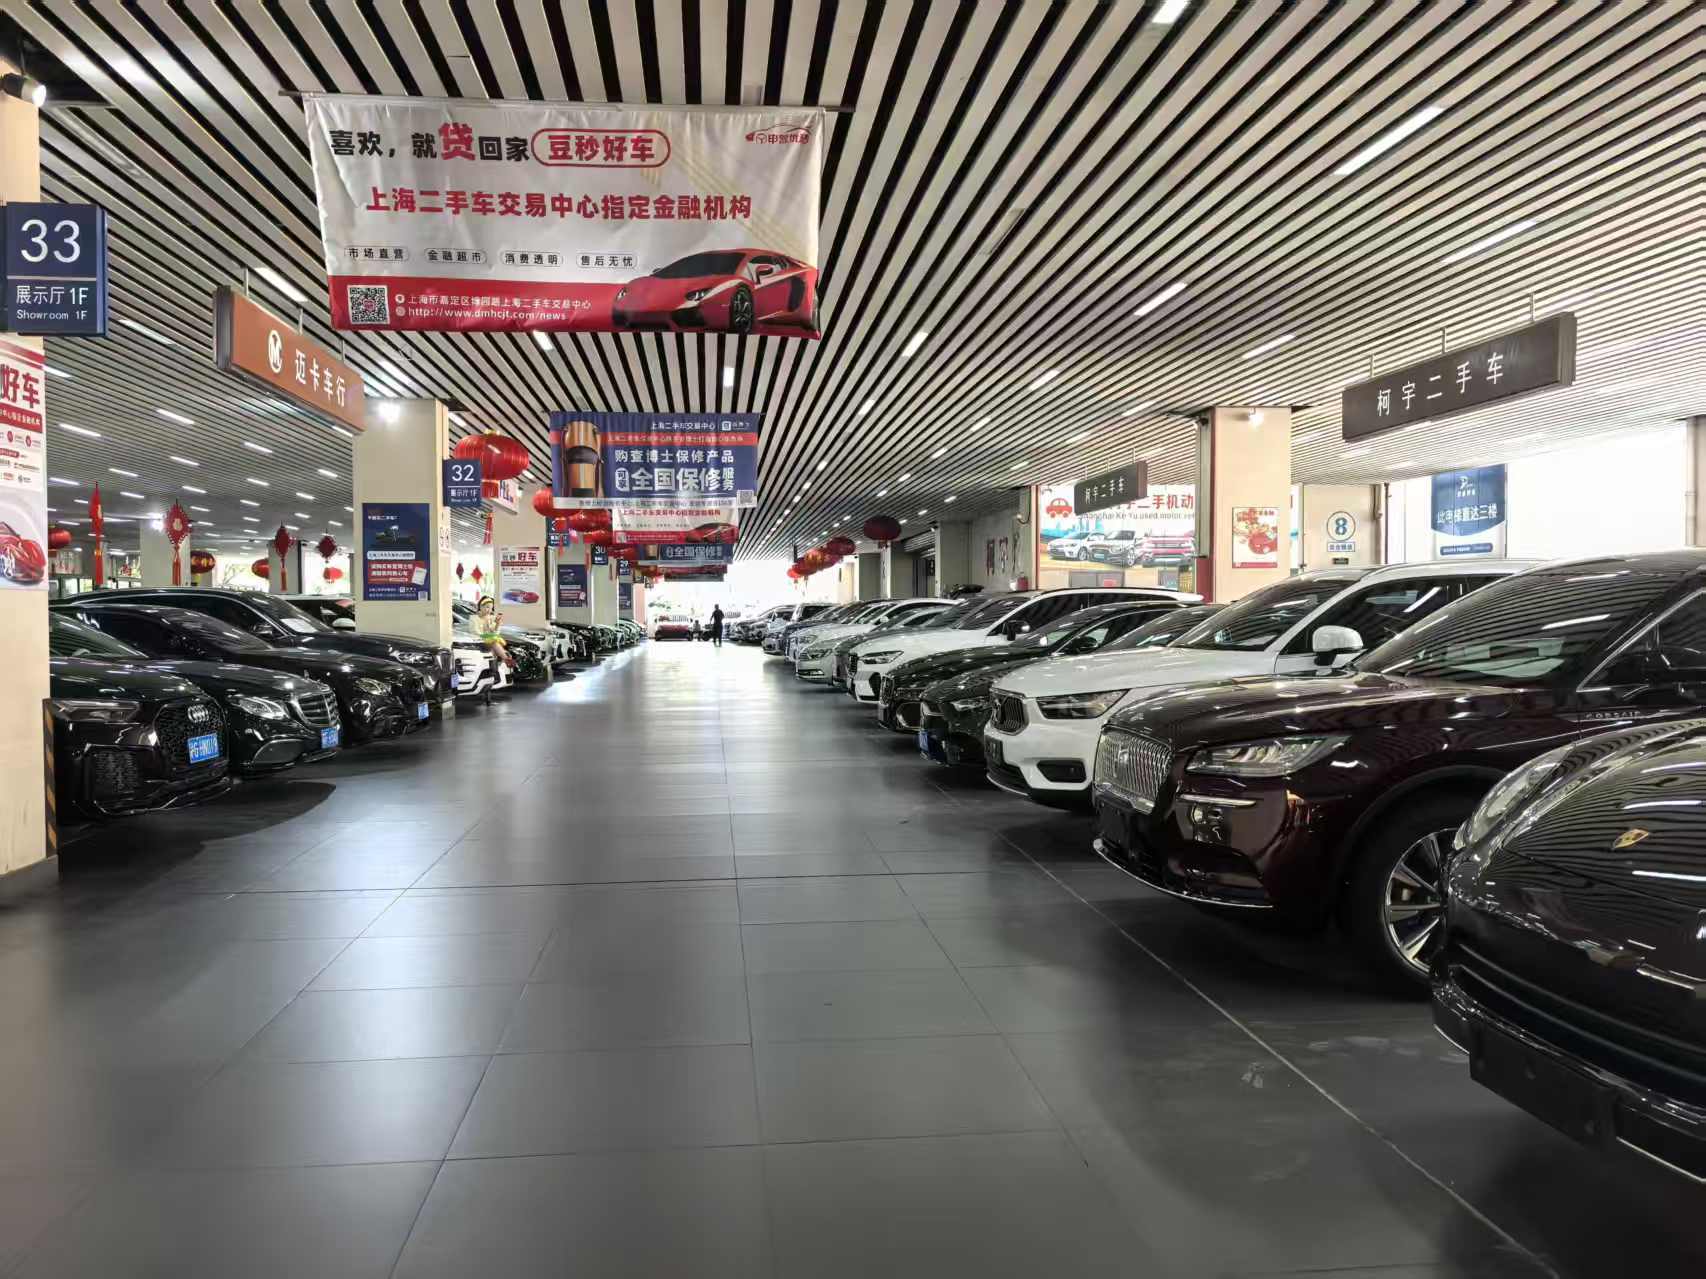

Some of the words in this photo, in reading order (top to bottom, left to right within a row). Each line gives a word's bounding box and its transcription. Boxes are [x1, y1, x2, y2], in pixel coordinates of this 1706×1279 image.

[547, 134, 655, 162] 豆秒好车
[366, 187, 752, 220] 上海二手车交易中心指定金融机构
[21, 219, 81, 263] 33
[349, 247, 405, 260] 市场直营
[428, 250, 482, 263] 金融超市
[505, 252, 559, 266] 消费透明
[580, 254, 634, 267] 售后无忧
[16, 285, 65, 305] 展示厅
[70, 287, 89, 305] 1F
[17, 309, 69, 320] Showroom
[75, 310, 88, 320] 1F
[295, 348, 346, 407] 迈卡车行
[1377, 351, 1504, 417] 柯宇二手车
[615, 449, 734, 463] 购查博士保修产品
[451, 464, 475, 482] 32
[631, 467, 721, 491] 全国保修
[1335, 517, 1347, 535] 8
